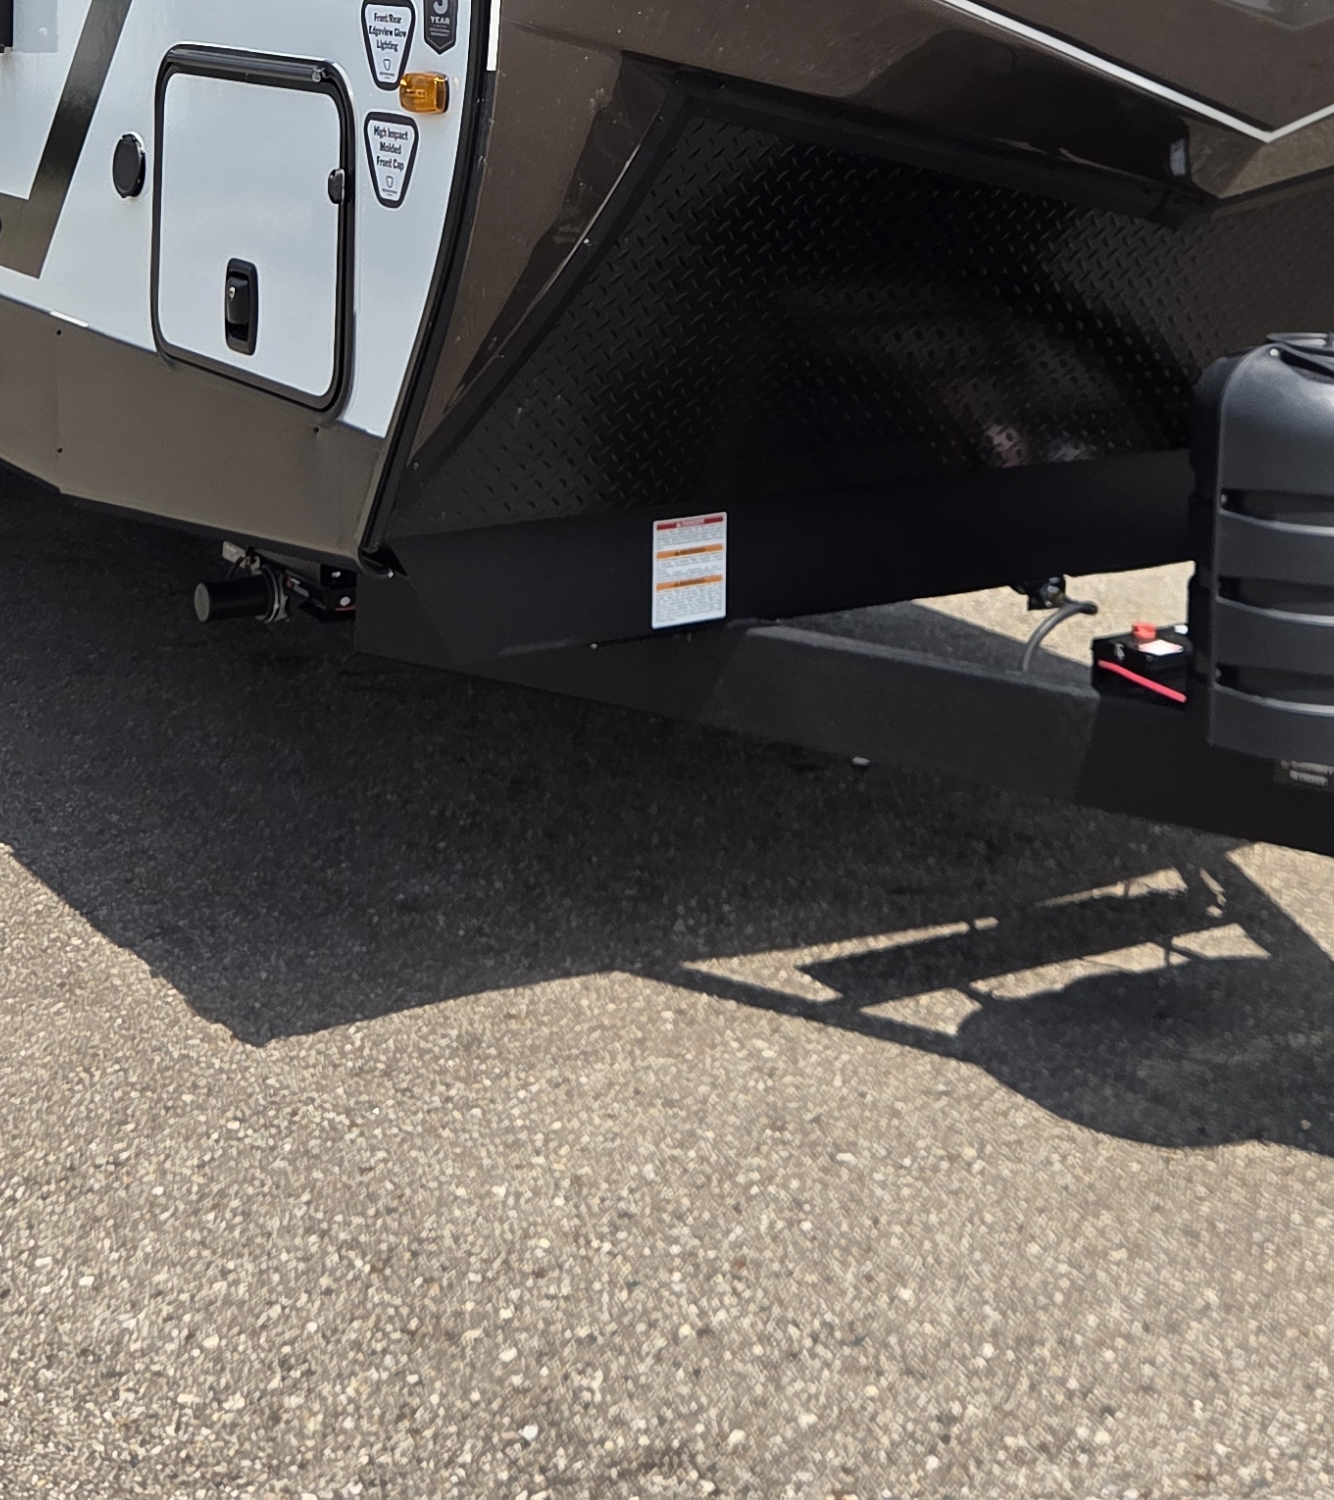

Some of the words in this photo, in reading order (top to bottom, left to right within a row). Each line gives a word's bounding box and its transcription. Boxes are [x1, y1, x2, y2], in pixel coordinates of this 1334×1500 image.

[430, 16, 450, 25] YEAR
[373, 125, 387, 139] High
[387, 128, 409, 141] Impact
[379, 141, 402, 155] Molded
[376, 155, 392, 169] Front
[392, 158, 405, 173] Cap
